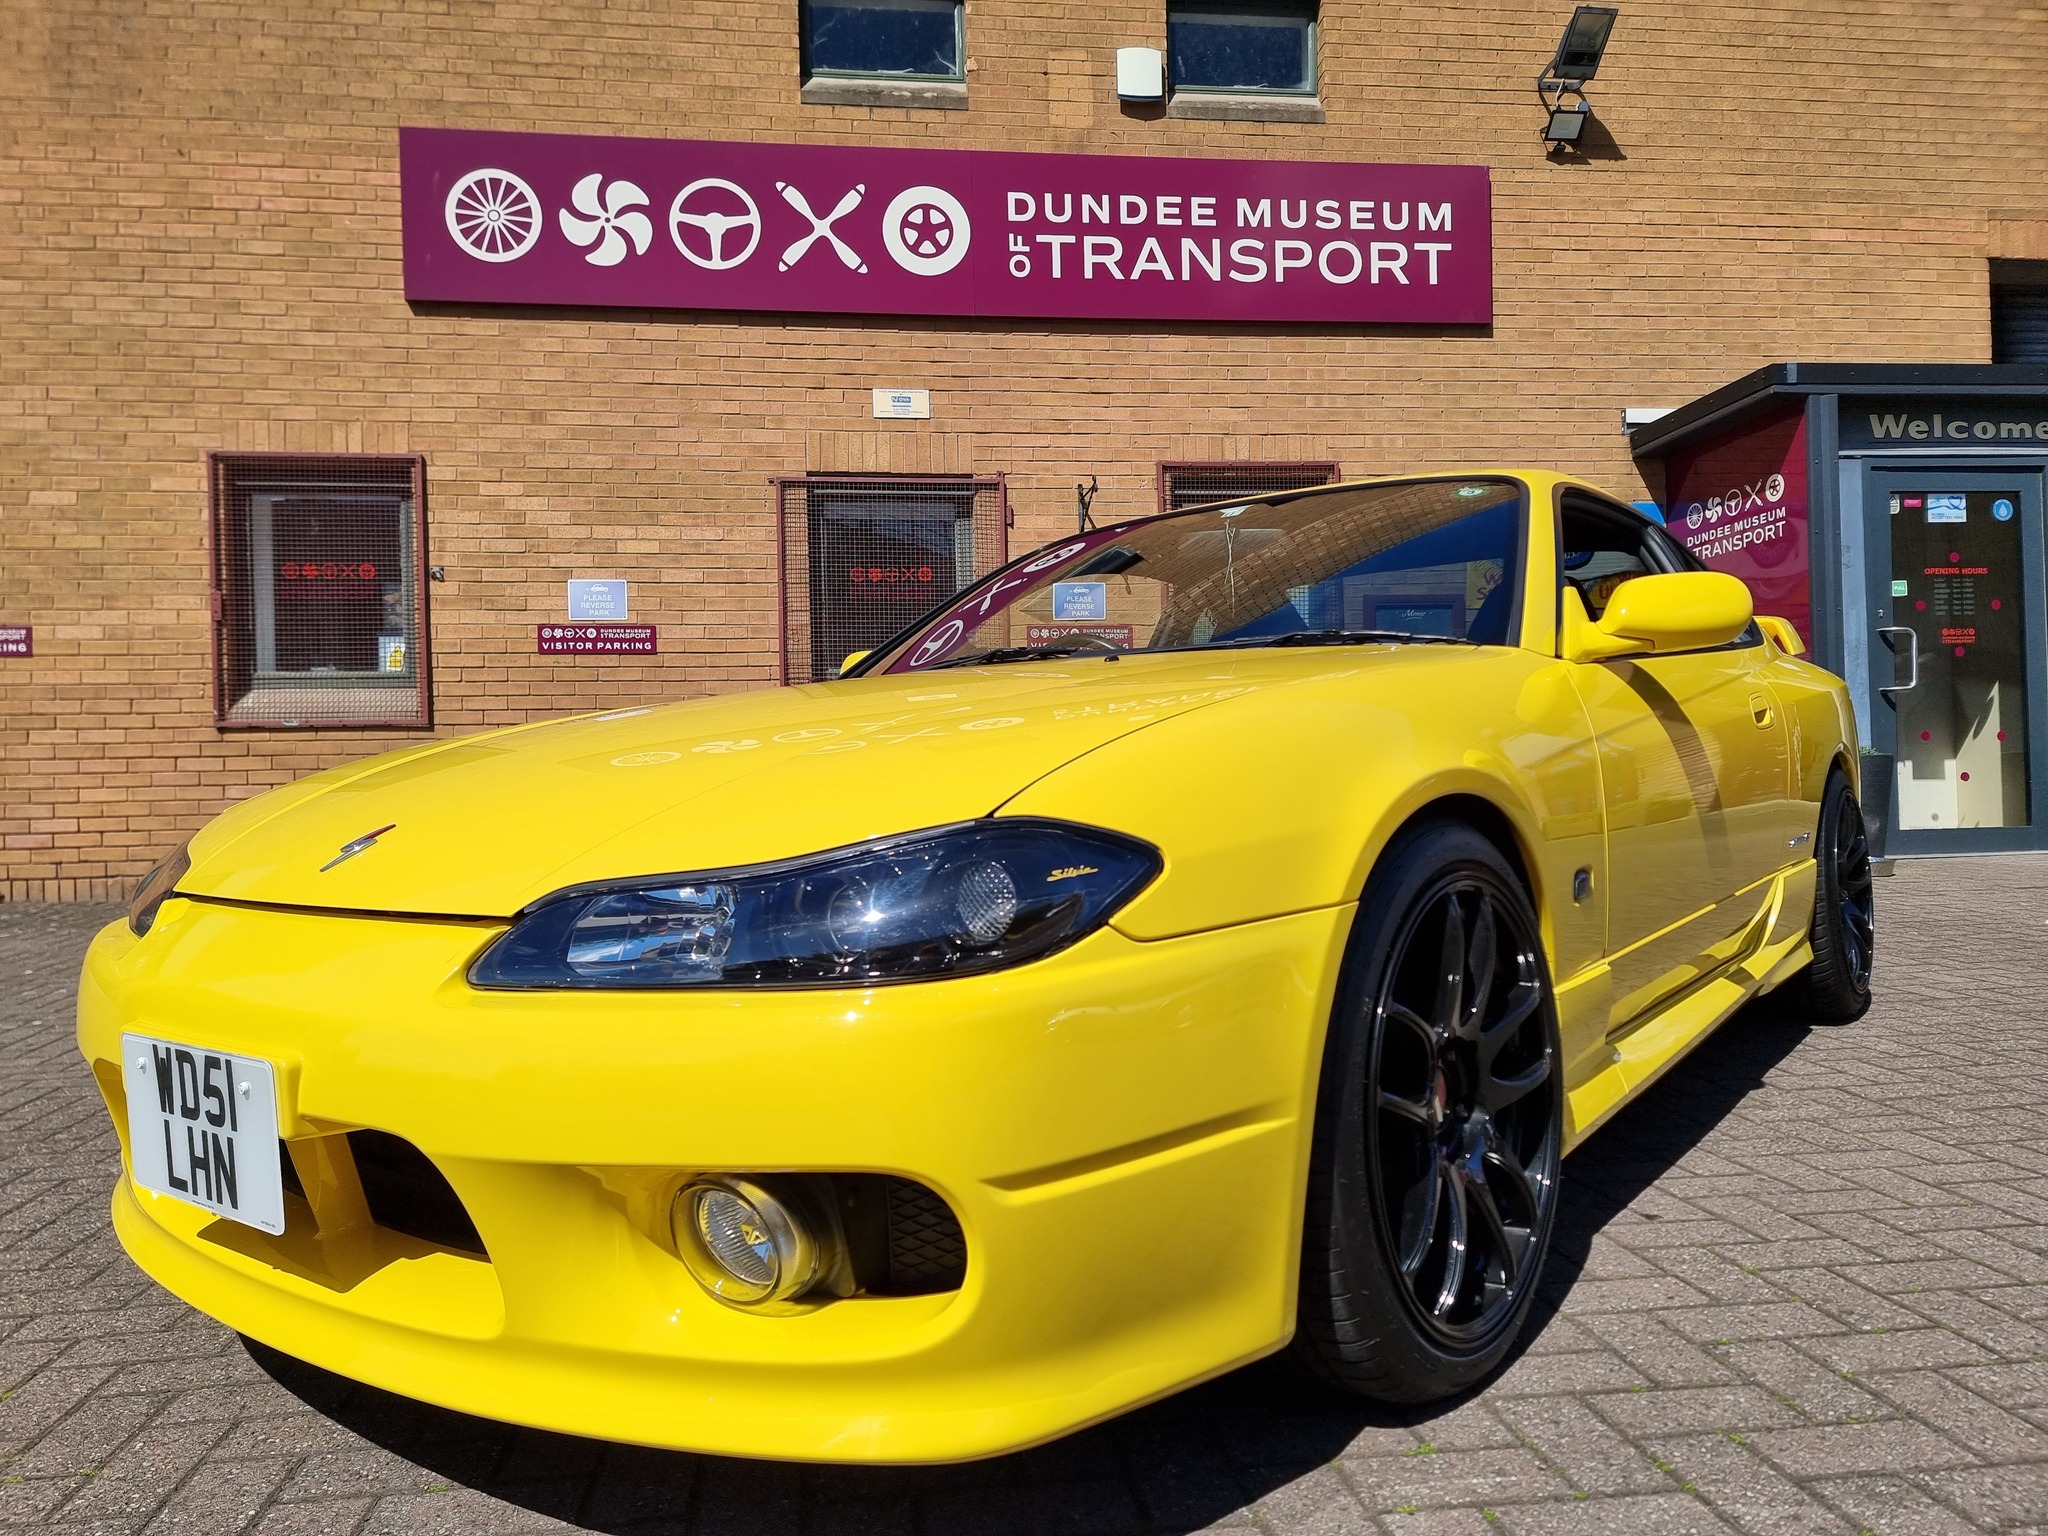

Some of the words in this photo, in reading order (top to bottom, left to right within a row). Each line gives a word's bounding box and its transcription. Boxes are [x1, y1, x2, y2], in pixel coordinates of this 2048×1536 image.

[1007, 191, 1217, 226] DUNDEE
[1237, 198, 1453, 231] MUSEUM
[1008, 233, 1031, 278] OF
[1036, 234, 1453, 285] TRANSPORT
[1868, 413, 2048, 440] Welcome
[1687, 524, 1731, 548] DUNDEE
[1734, 506, 1786, 533] MUSEUM
[1693, 521, 1786, 560] TRANSPORT
[1924, 567, 1960, 575] OPENING
[1962, 567, 1988, 575] HOURS
[542, 642, 593, 650] VISITOR
[597, 642, 652, 650] PARKING
[1046, 864, 1099, 882] Silvia
[152, 1043, 238, 1133] WD51
[164, 1118, 239, 1211] LHN
